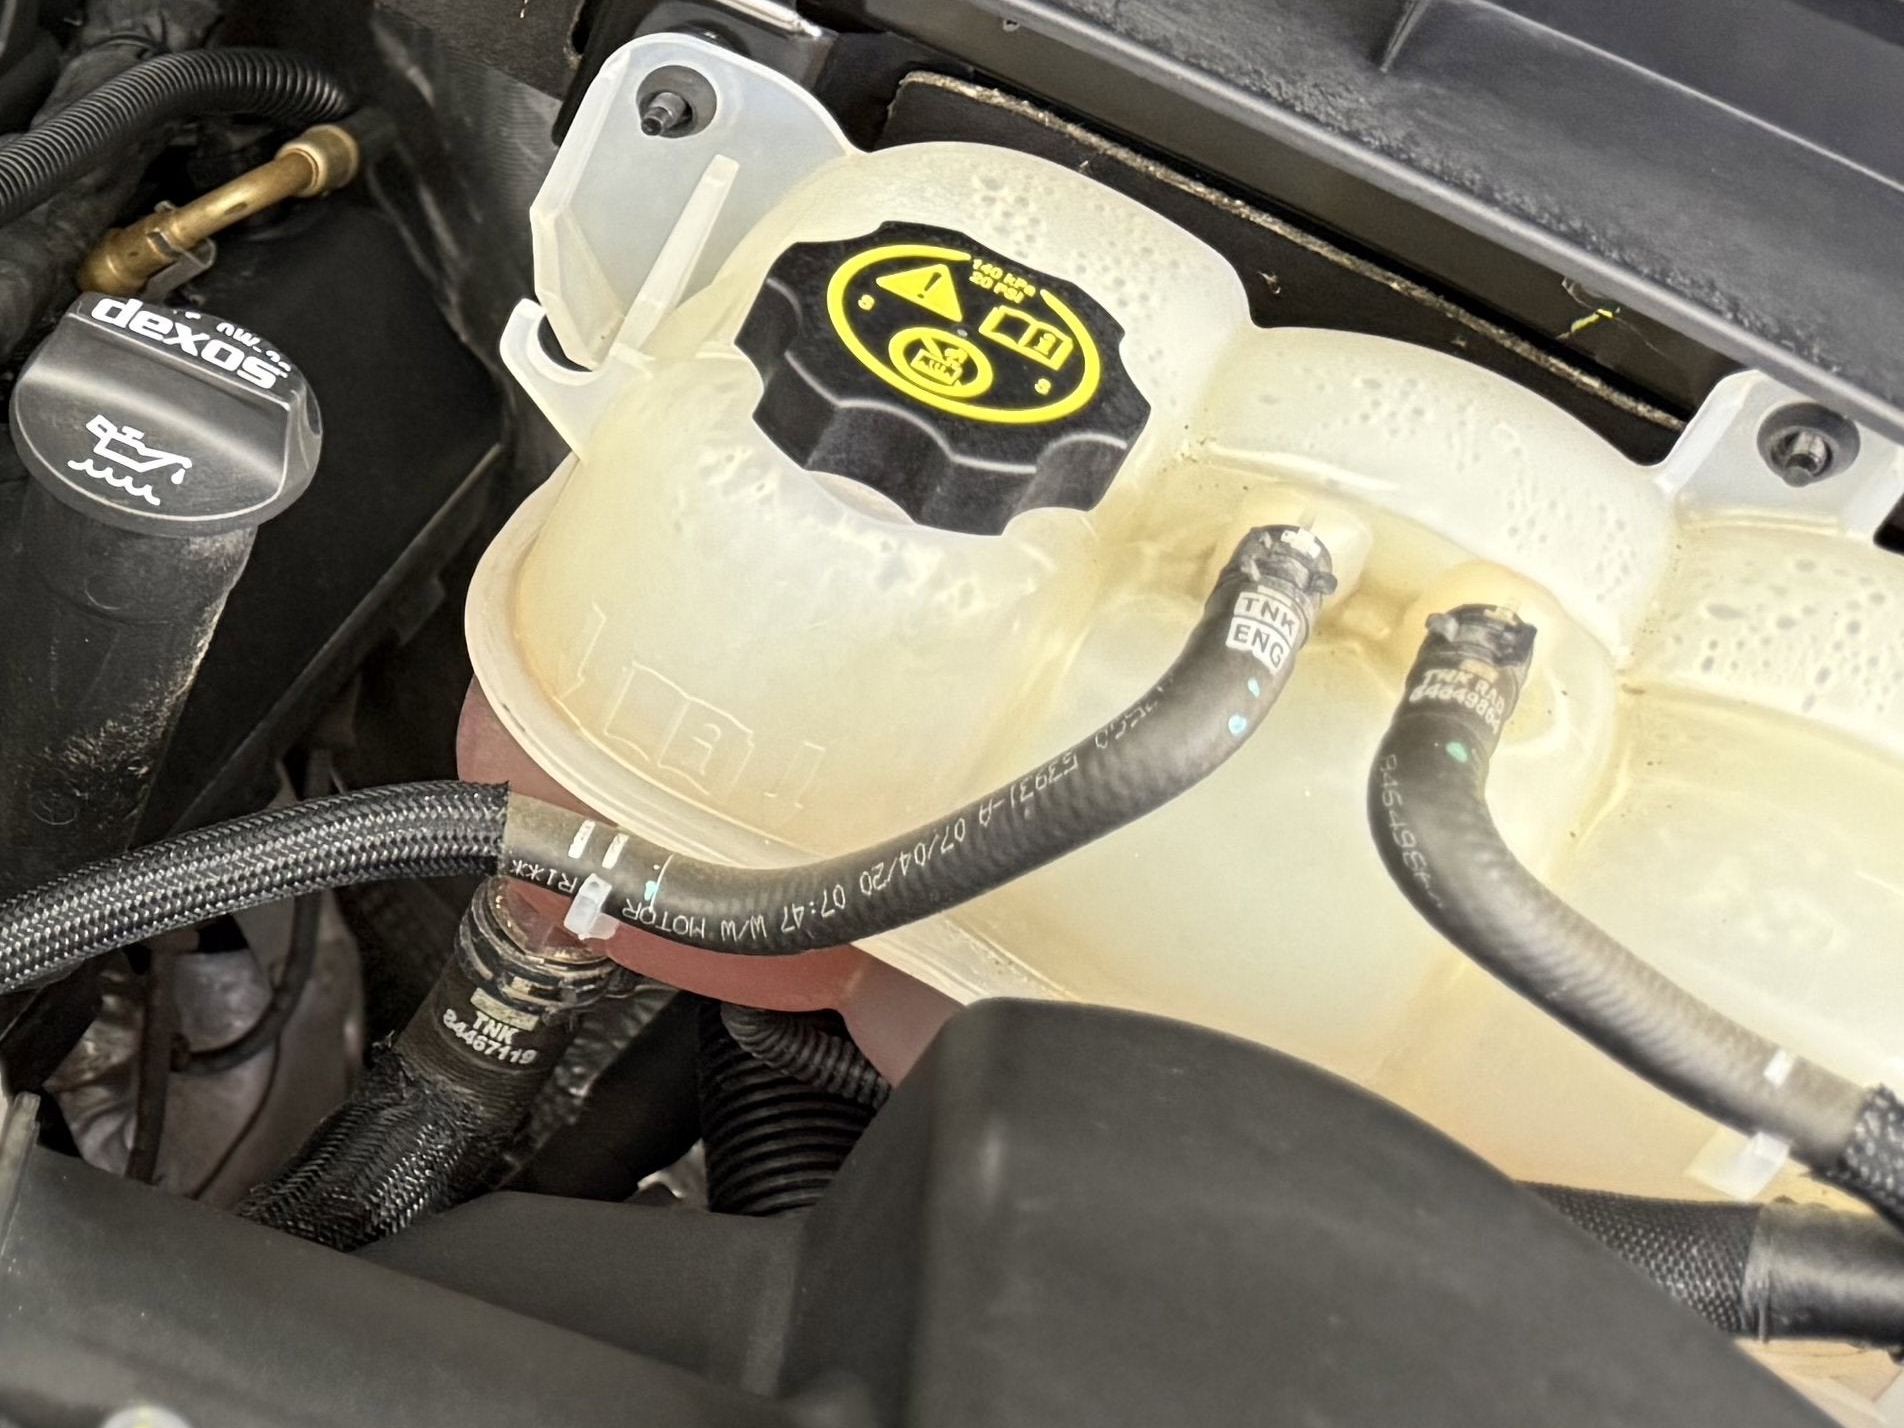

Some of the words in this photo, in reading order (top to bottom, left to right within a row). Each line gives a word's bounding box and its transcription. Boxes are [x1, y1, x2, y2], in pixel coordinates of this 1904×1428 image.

[972, 258, 1003, 280] 140
[91, 298, 276, 389] dexos
[1241, 596, 1295, 636] TNK
[1233, 623, 1284, 669] ENG
[859, 818, 966, 897] 07/04/20
[621, 898, 705, 939] MOTOR
[780, 883, 846, 932] 07:47
[443, 1008, 537, 1064] 84467119
[473, 1010, 519, 1045] TNK
